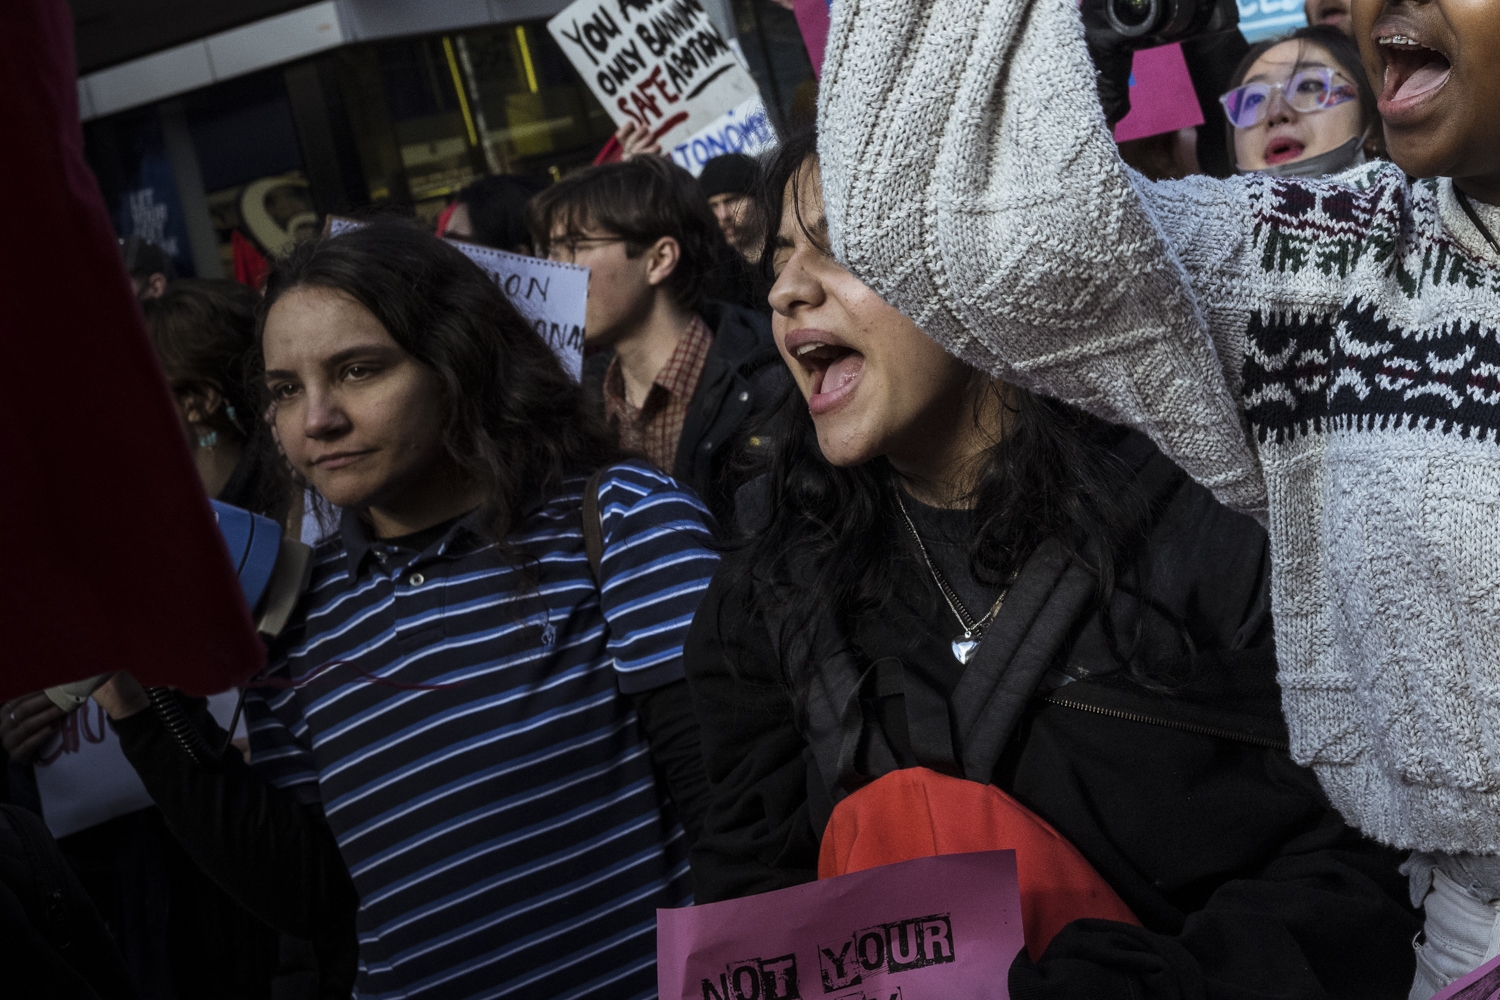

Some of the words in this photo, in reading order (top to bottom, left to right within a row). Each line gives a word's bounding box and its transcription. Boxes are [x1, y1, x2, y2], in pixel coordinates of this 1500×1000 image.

[561, 5, 622, 66] YOU
[597, 39, 647, 97] ONLY
[617, 65, 680, 127] SAFE
[817, 912, 956, 994] YOUR
